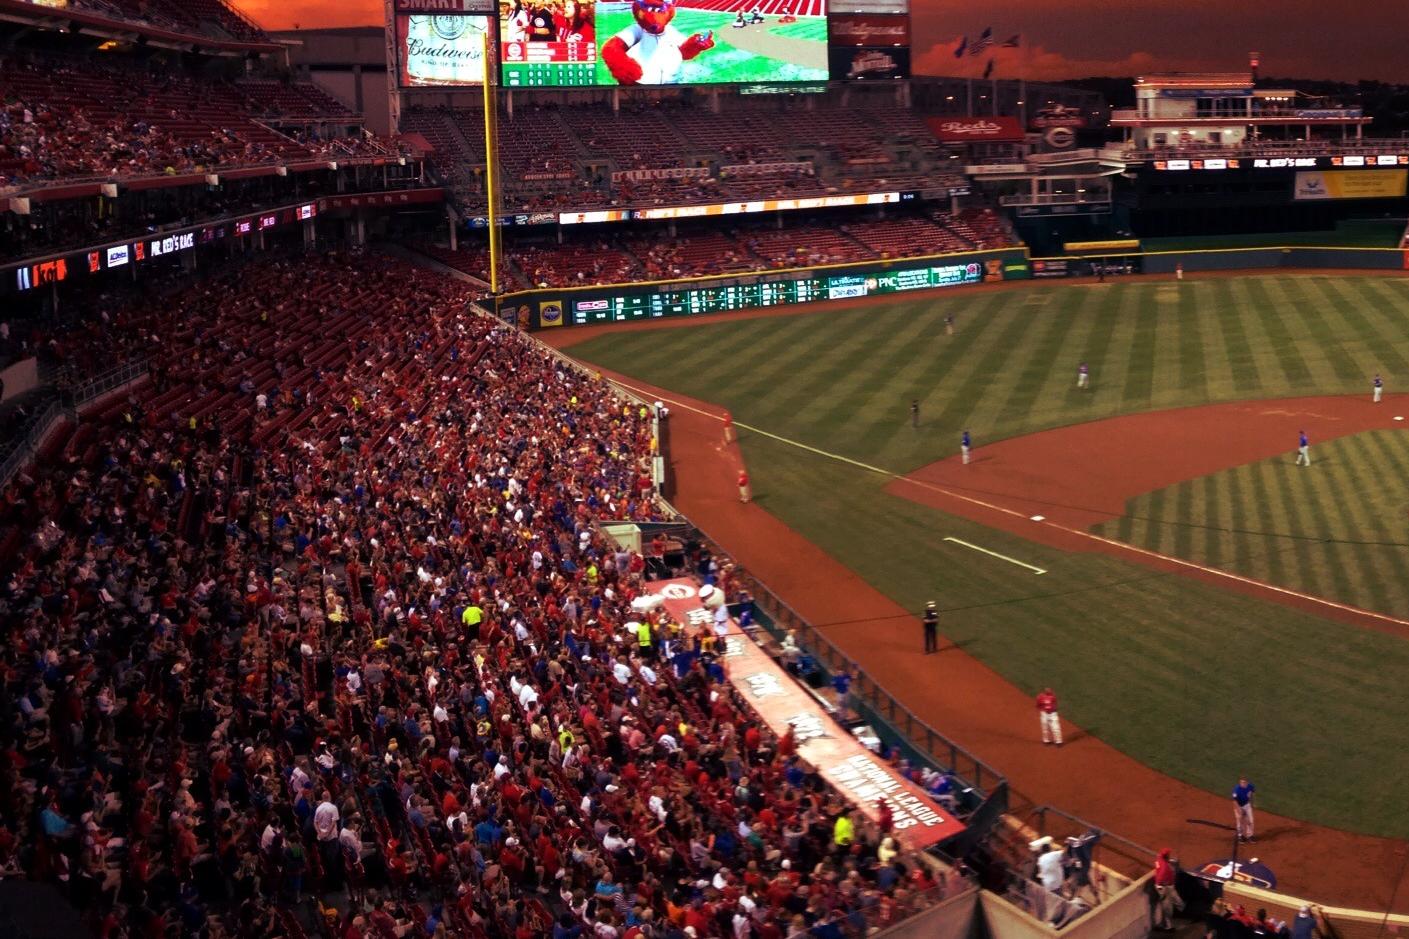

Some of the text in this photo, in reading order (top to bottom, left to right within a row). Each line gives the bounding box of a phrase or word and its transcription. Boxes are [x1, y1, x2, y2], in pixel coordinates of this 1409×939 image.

[407, 38, 483, 60] Budweise
[941, 120, 1002, 133] Reds
[878, 277, 898, 287] PNC
[847, 754, 945, 827] NATIONAL LEAGUE
